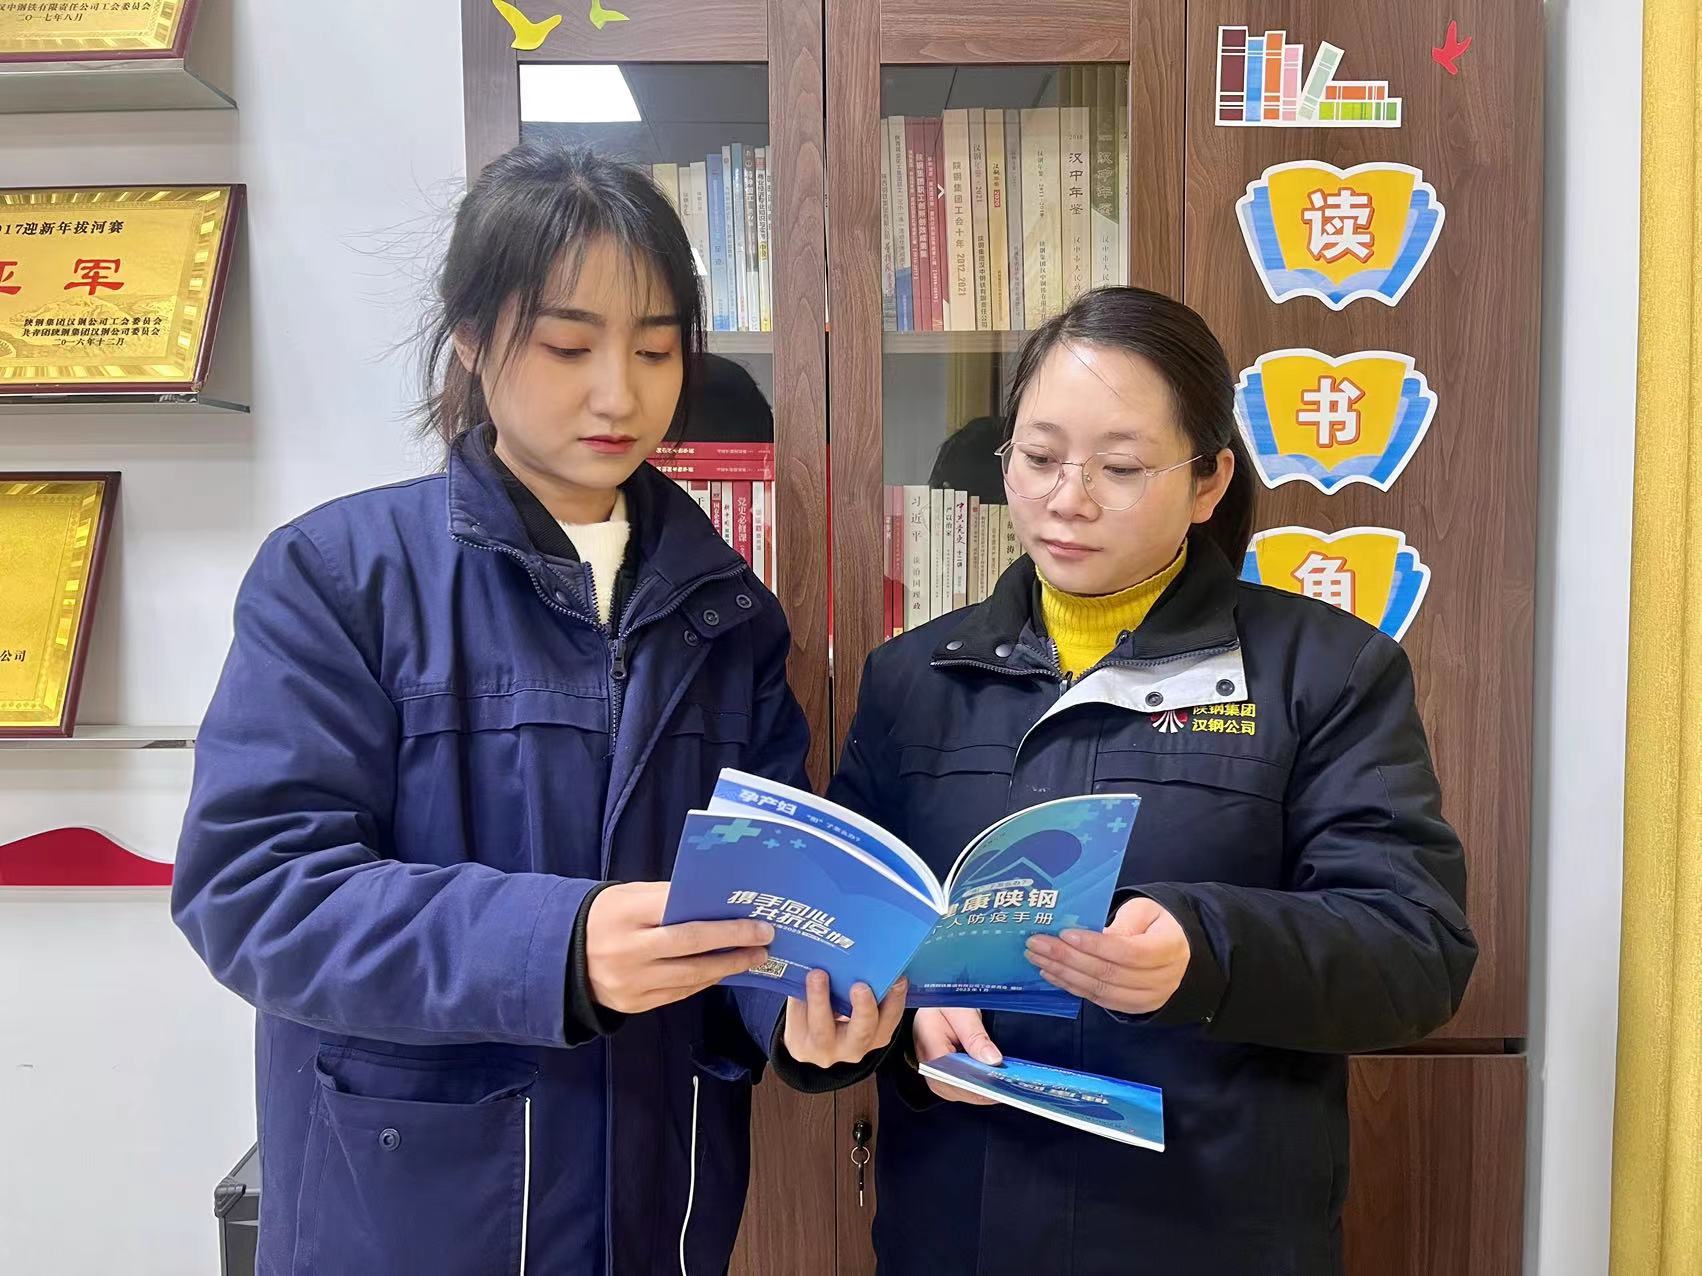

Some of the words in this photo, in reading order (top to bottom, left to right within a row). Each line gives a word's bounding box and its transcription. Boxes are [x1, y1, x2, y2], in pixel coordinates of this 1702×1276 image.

[952, 161, 965, 249] 陕钢集团工会十年
[993, 189, 1001, 208] 2020
[1068, 152, 1084, 215] 汉中年鉴
[0, 220, 124, 235] 17迎新年拔河赛
[1303, 188, 1374, 262] 读
[23, 317, 163, 327] 陕钢集团汉钢公司工会委员会
[1297, 376, 1364, 447] 书
[911, 496, 921, 542] 习近平
[913, 556, 921, 609] 谈治国理政
[1291, 552, 1355, 615] 角
[1192, 718, 1256, 735] 汉钢公司
[739, 789, 798, 816] 孕产妇
[727, 890, 836, 926] 携手同心
[748, 906, 856, 949] 共抗疫情
